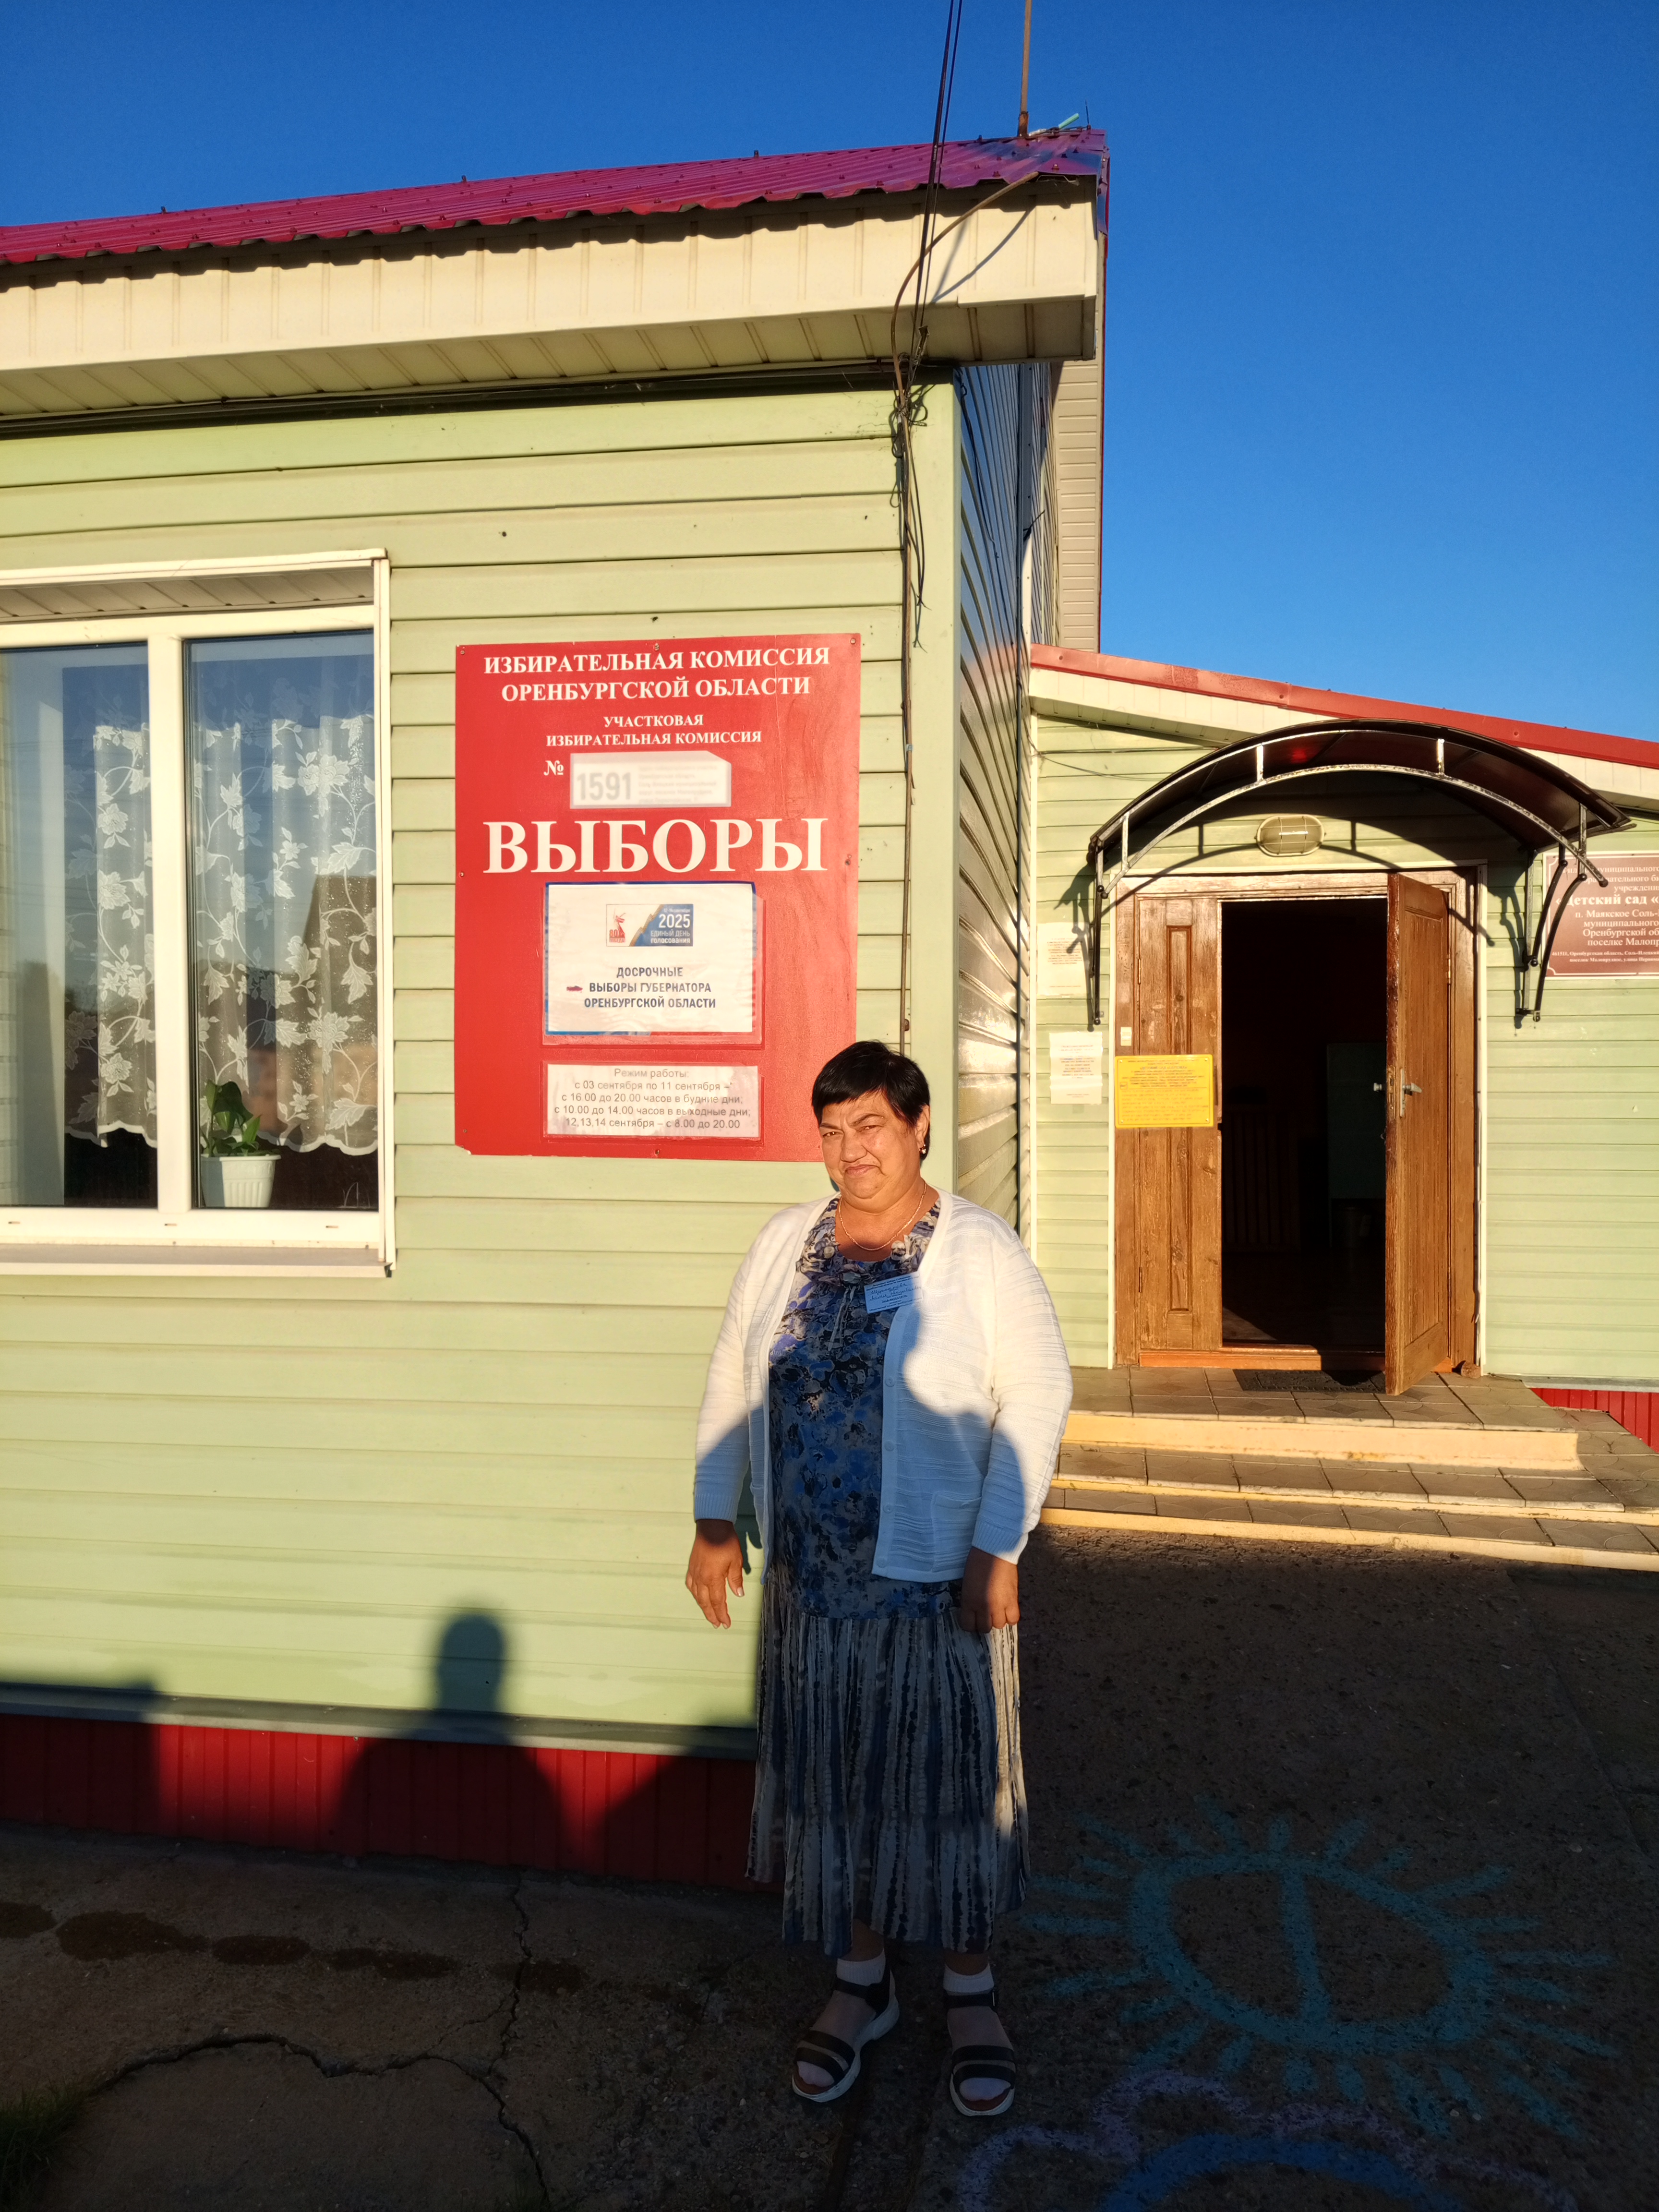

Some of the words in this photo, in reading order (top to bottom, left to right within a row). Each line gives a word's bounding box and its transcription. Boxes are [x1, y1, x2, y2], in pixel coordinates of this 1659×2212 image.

[484, 651, 685, 674] ИЗБИРАТЕЛЬНАЯ
[690, 648, 830, 669] КОМИССИЯ
[502, 676, 689, 701] ОРЕНБУРГСКОЙ
[695, 677, 811, 697] ОБЛАСТИ
[604, 714, 704, 728] УЧАСТКОВАЯ
[546, 733, 671, 747] ИЗБИРАТЕЛЬНАЯ
[675, 731, 762, 744] КОМИССИЯ
[577, 771, 632, 801] 1591
[483, 818, 829, 874] ВЫБОРЫ
[1625, 896, 1647, 905] сад
[1587, 910, 1630, 918] Маякское
[659, 914, 690, 928] 2025
[1584, 920, 1659, 929] муниципального
[1583, 928, 1646, 938] Оренбургской
[616, 967, 683, 978] ДОСРОЧНЫЕ
[589, 983, 637, 992] ВЫБОРЫ
[640, 983, 711, 992] ГУБЕРНАТОРА
[584, 996, 665, 1008] ОРЕНБУРГСКОЙ
[668, 998, 716, 1008] ОБЛАСТИ
[614, 1069, 648, 1077] Режим
[650, 1069, 689, 1078] работы:
[583, 1080, 594, 1089] 03
[598, 1081, 642, 1091] сентября
[661, 1082, 671, 1090] 11
[675, 1082, 720, 1092] сентября
[570, 1093, 596, 1102] 16.00
[599, 1095, 612, 1103] до
[614, 1094, 641, 1102] 20.00
[684, 1094, 718, 1105] будние
[564, 1106, 589, 1114] 10.00
[608, 1106, 633, 1115] 14.00
[566, 1118, 606, 1127] 12,13,14
[609, 1118, 654, 1128] сентября
[674, 1119, 695, 1128] 8.00
[697, 1121, 710, 1129] до
[713, 1120, 740, 1129] 20.00
